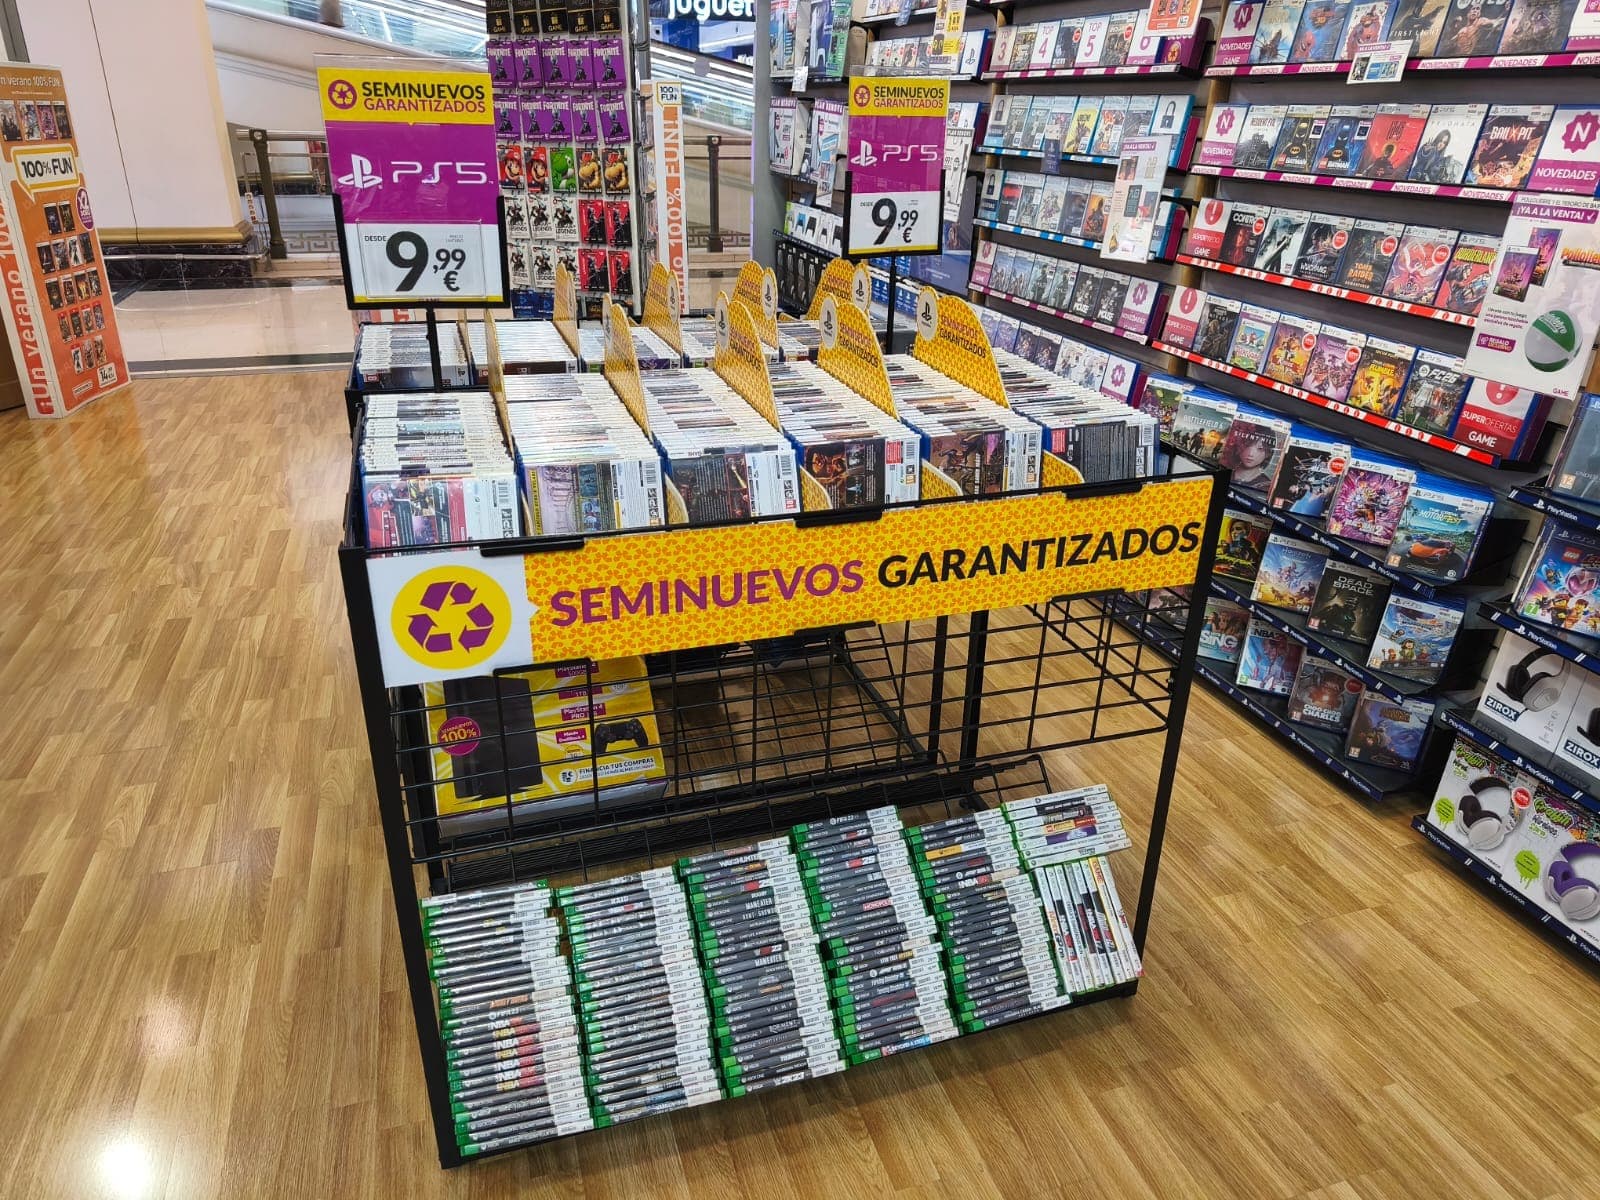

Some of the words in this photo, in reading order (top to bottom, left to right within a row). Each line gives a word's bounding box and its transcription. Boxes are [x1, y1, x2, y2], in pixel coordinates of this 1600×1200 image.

[1088, 21, 1102, 32] TOP
[997, 43, 1006, 60] 3
[1039, 38, 1048, 58] 4
[1084, 35, 1096, 57] 5
[1220, 42, 1252, 51] NOVEDADES
[1492, 58, 1538, 67] NOVEDADES
[361, 81, 485, 100] SEMINUEVOS
[661, 92, 679, 102] FUN
[873, 85, 945, 100] SEMINUEVOS
[363, 97, 486, 113] GARANTIZADOS
[873, 98, 944, 109] GARANTIZADOS
[1517, 127, 1537, 140] PIT
[882, 144, 940, 162] PS5
[1203, 146, 1233, 156] NOVEDADES
[21, 160, 52, 179] 100%
[52, 157, 74, 176] FUN
[1327, 160, 1349, 169] BATMAN
[391, 161, 488, 185] PS5
[1535, 167, 1597, 180] NOVEDADES
[1393, 183, 1432, 193] NOVEDADES
[1462, 190, 1504, 200] NOVEDADES
[1516, 205, 1530, 216] ¡YA
[1530, 206, 1537, 216] A
[1539, 207, 1551, 217] LA
[1551, 208, 1585, 221] VENTA!
[902, 227, 912, 243] €
[1194, 247, 1211, 257] GAME
[1347, 268, 1374, 282] RAIDER
[1354, 263, 1373, 272] TOMB
[443, 270, 461, 292] €
[8, 269, 42, 357] verano
[1073, 302, 1090, 314] MOUSE
[1097, 309, 1114, 322] MOUSE
[839, 322, 873, 348] SEMINUEVOS
[940, 314, 979, 341] SEMINUEVOS
[939, 329, 987, 359] GARANTIZADOS
[1169, 334, 1186, 345] GAME
[838, 335, 879, 369] GARANTIZADOS
[1368, 363, 1396, 377] RUMBLE
[1552, 387, 1570, 397] GAME
[1183, 414, 1217, 429] BATTLEFIELD
[1461, 410, 1518, 434] SUPEROFERTAS
[1233, 430, 1259, 440] SILENT
[1260, 436, 1277, 446] HILL
[1468, 430, 1498, 448] GAME
[1419, 510, 1463, 525] MOTORFEST
[1546, 504, 1578, 521] PlayStation
[1563, 551, 1580, 560] LEGO
[550, 559, 865, 627] SEMINUEVOS
[877, 520, 1202, 588] GARANTIZADOS
[1377, 565, 1400, 581] PlayStation
[1332, 580, 1374, 596] SPACE
[1337, 575, 1374, 589] DEAD
[1254, 628, 1275, 638] NBA
[1527, 631, 1558, 650] PlayStation
[570, 711, 584, 720] PRO
[1302, 708, 1341, 723] CHARLES
[1303, 703, 1342, 717] CHOO-CHOO
[1485, 696, 1519, 721] ZIROX
[1448, 717, 1475, 737] PlayStation
[440, 727, 478, 744] 100%
[1565, 740, 1600, 767] ZIROX
[610, 762, 624, 771] TUS
[623, 757, 655, 769] COMPRAS
[1525, 760, 1555, 785] PlayStation
[1427, 830, 1451, 850] PlayStation
[1499, 882, 1526, 906] PlayStation
[745, 897, 773, 910] MANEATER
